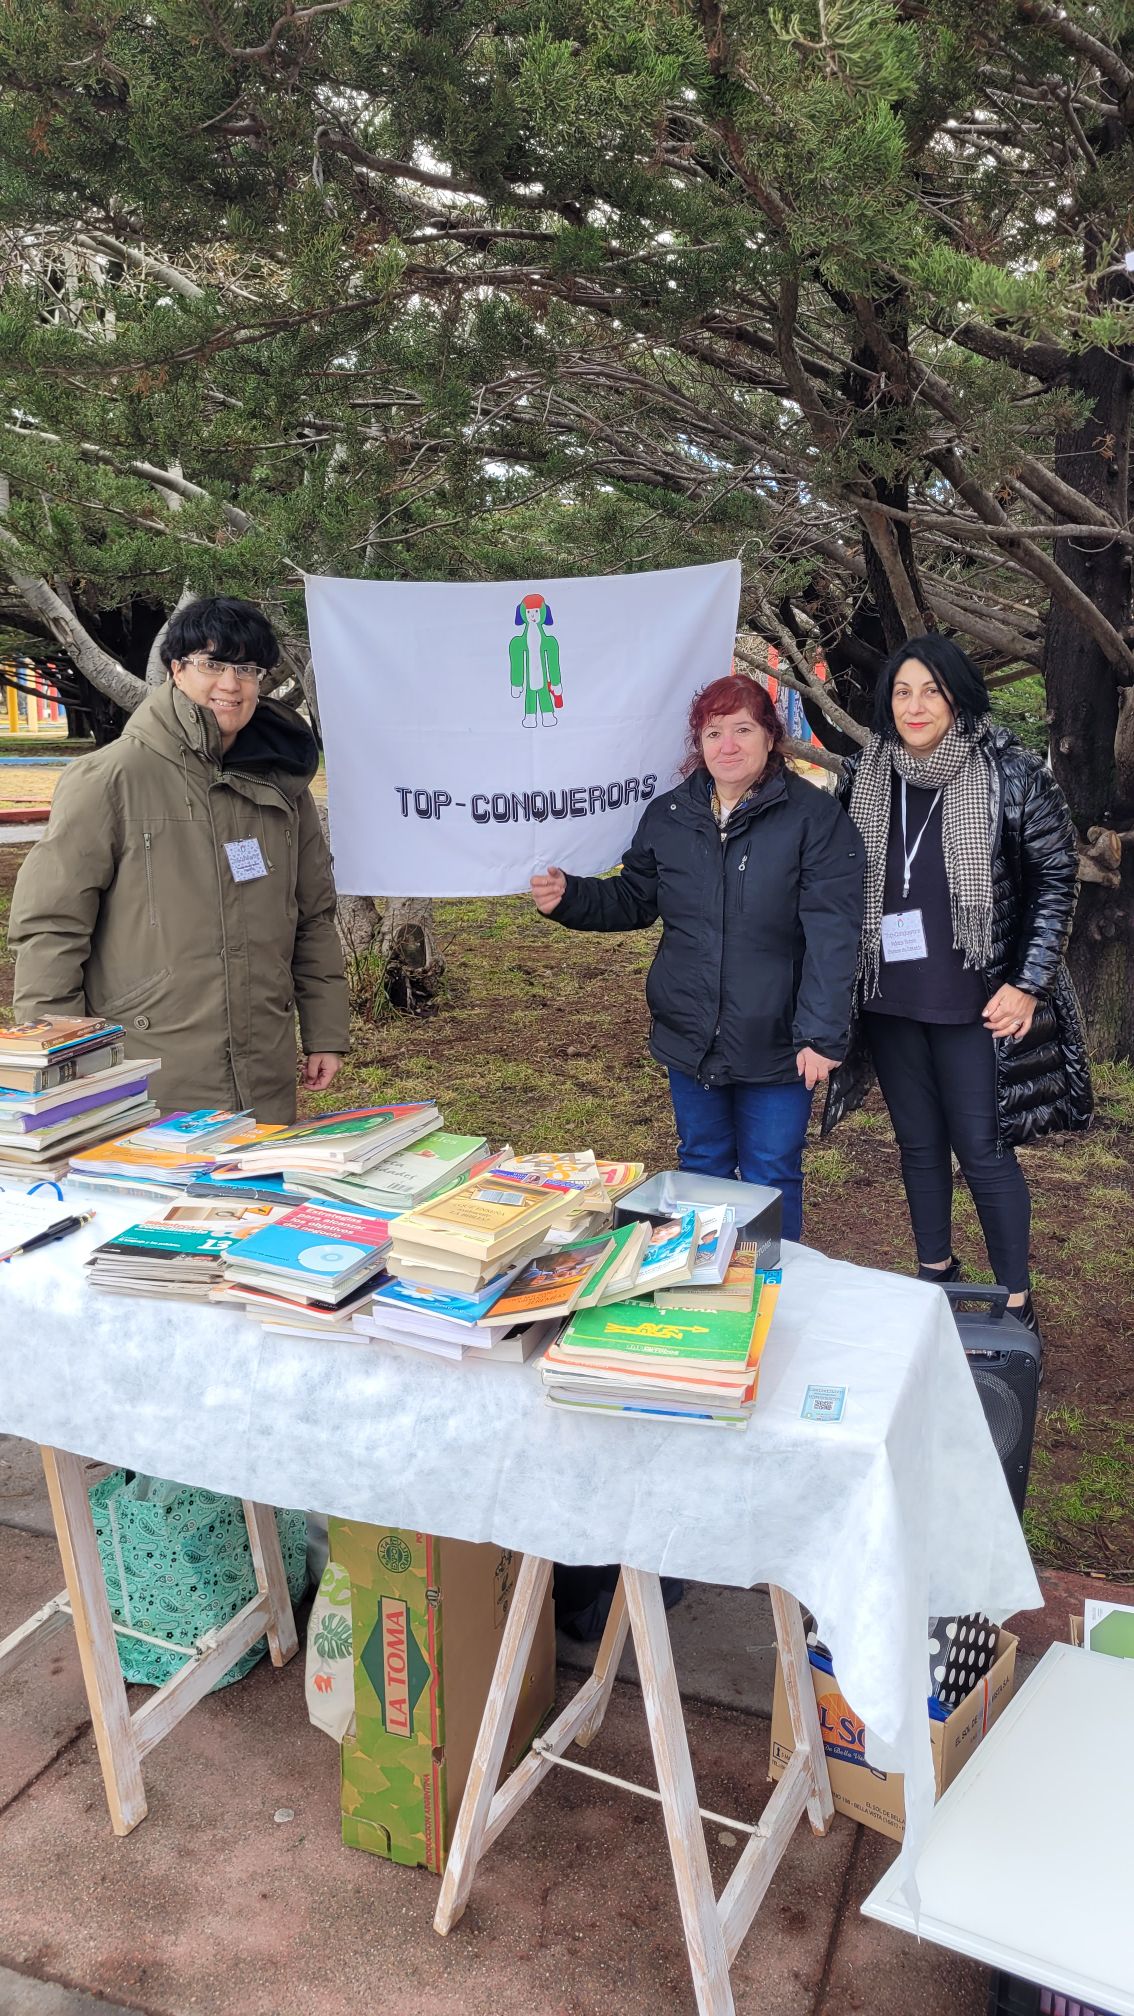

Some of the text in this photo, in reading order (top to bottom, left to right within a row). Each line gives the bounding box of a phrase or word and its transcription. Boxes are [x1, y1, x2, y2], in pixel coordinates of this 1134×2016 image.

[394, 773, 658, 824] TOP-CONQUERORS
[296, 1213, 366, 1231] para alcanzar
[305, 1208, 362, 1224] Estrategias
[283, 1222, 342, 1239] del negocio
[291, 1217, 355, 1235] los objetivos
[197, 1238, 233, 1250] 13
[385, 1610, 408, 1728] LA TOMA
